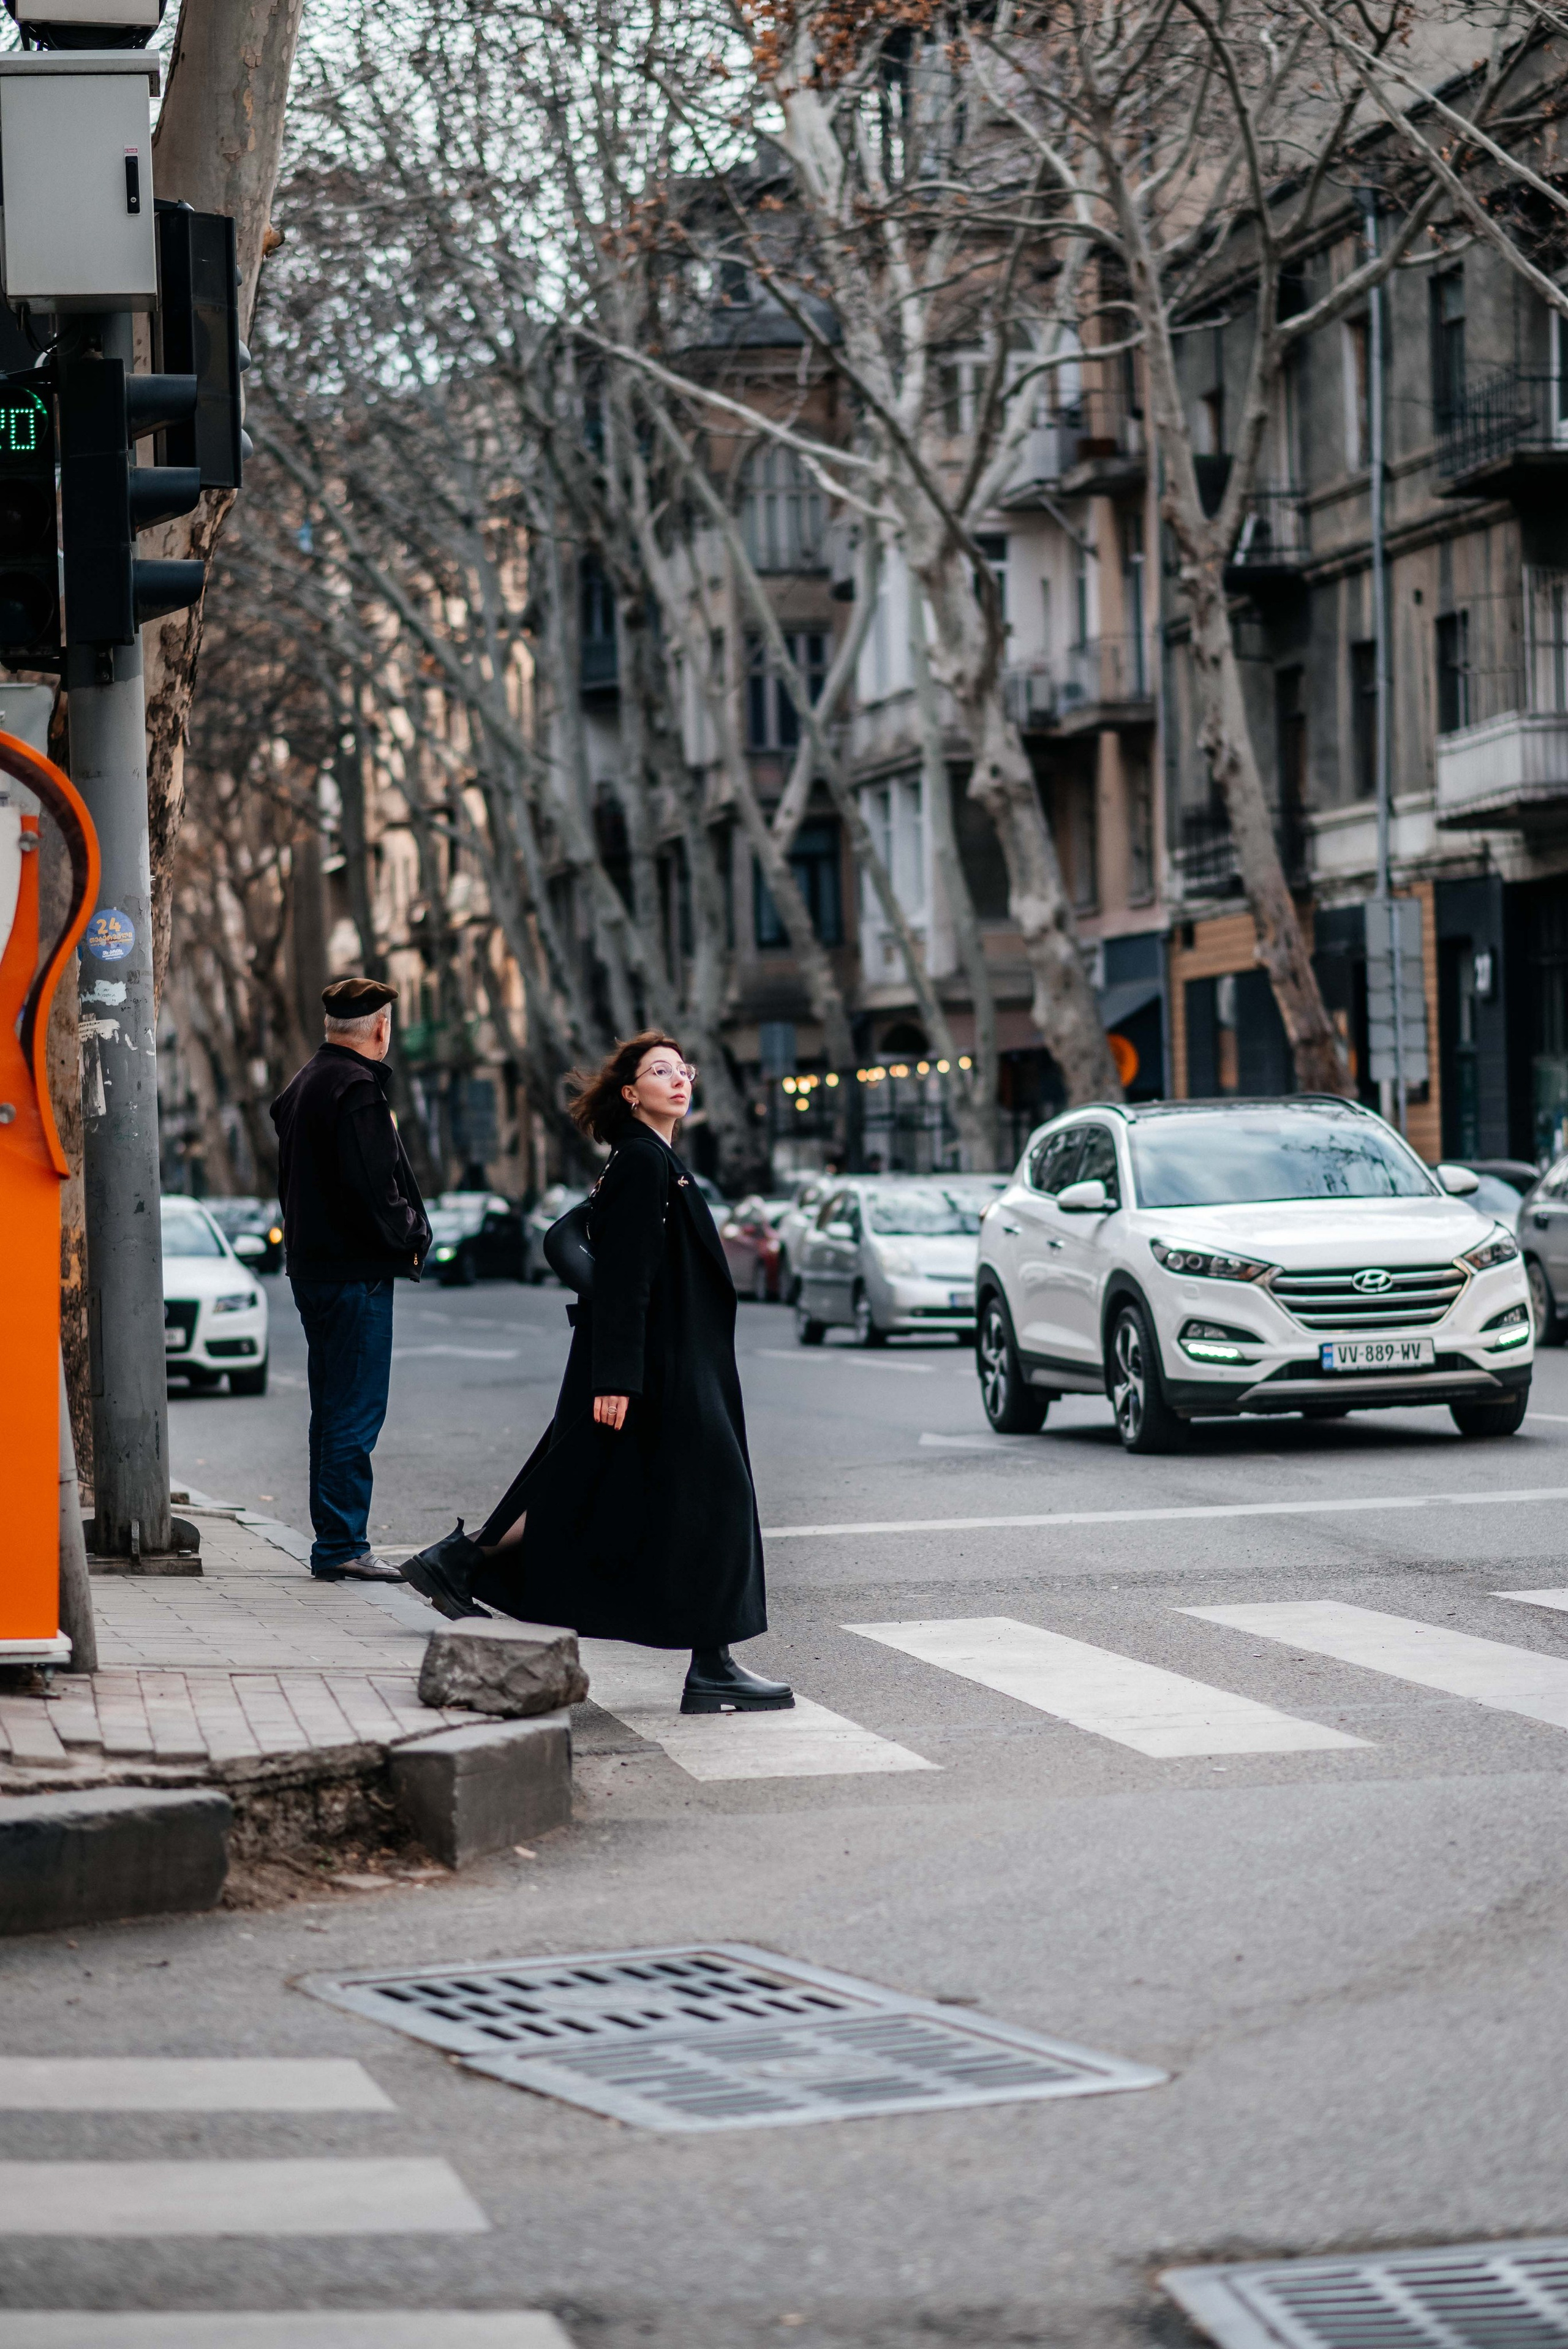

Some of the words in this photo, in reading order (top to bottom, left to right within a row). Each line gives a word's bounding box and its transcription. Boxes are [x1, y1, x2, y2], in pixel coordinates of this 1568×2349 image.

[0, 409, 36, 450] 0
[97, 918, 121, 934] 24
[1338, 1343, 1421, 1363] VV-889-WV
